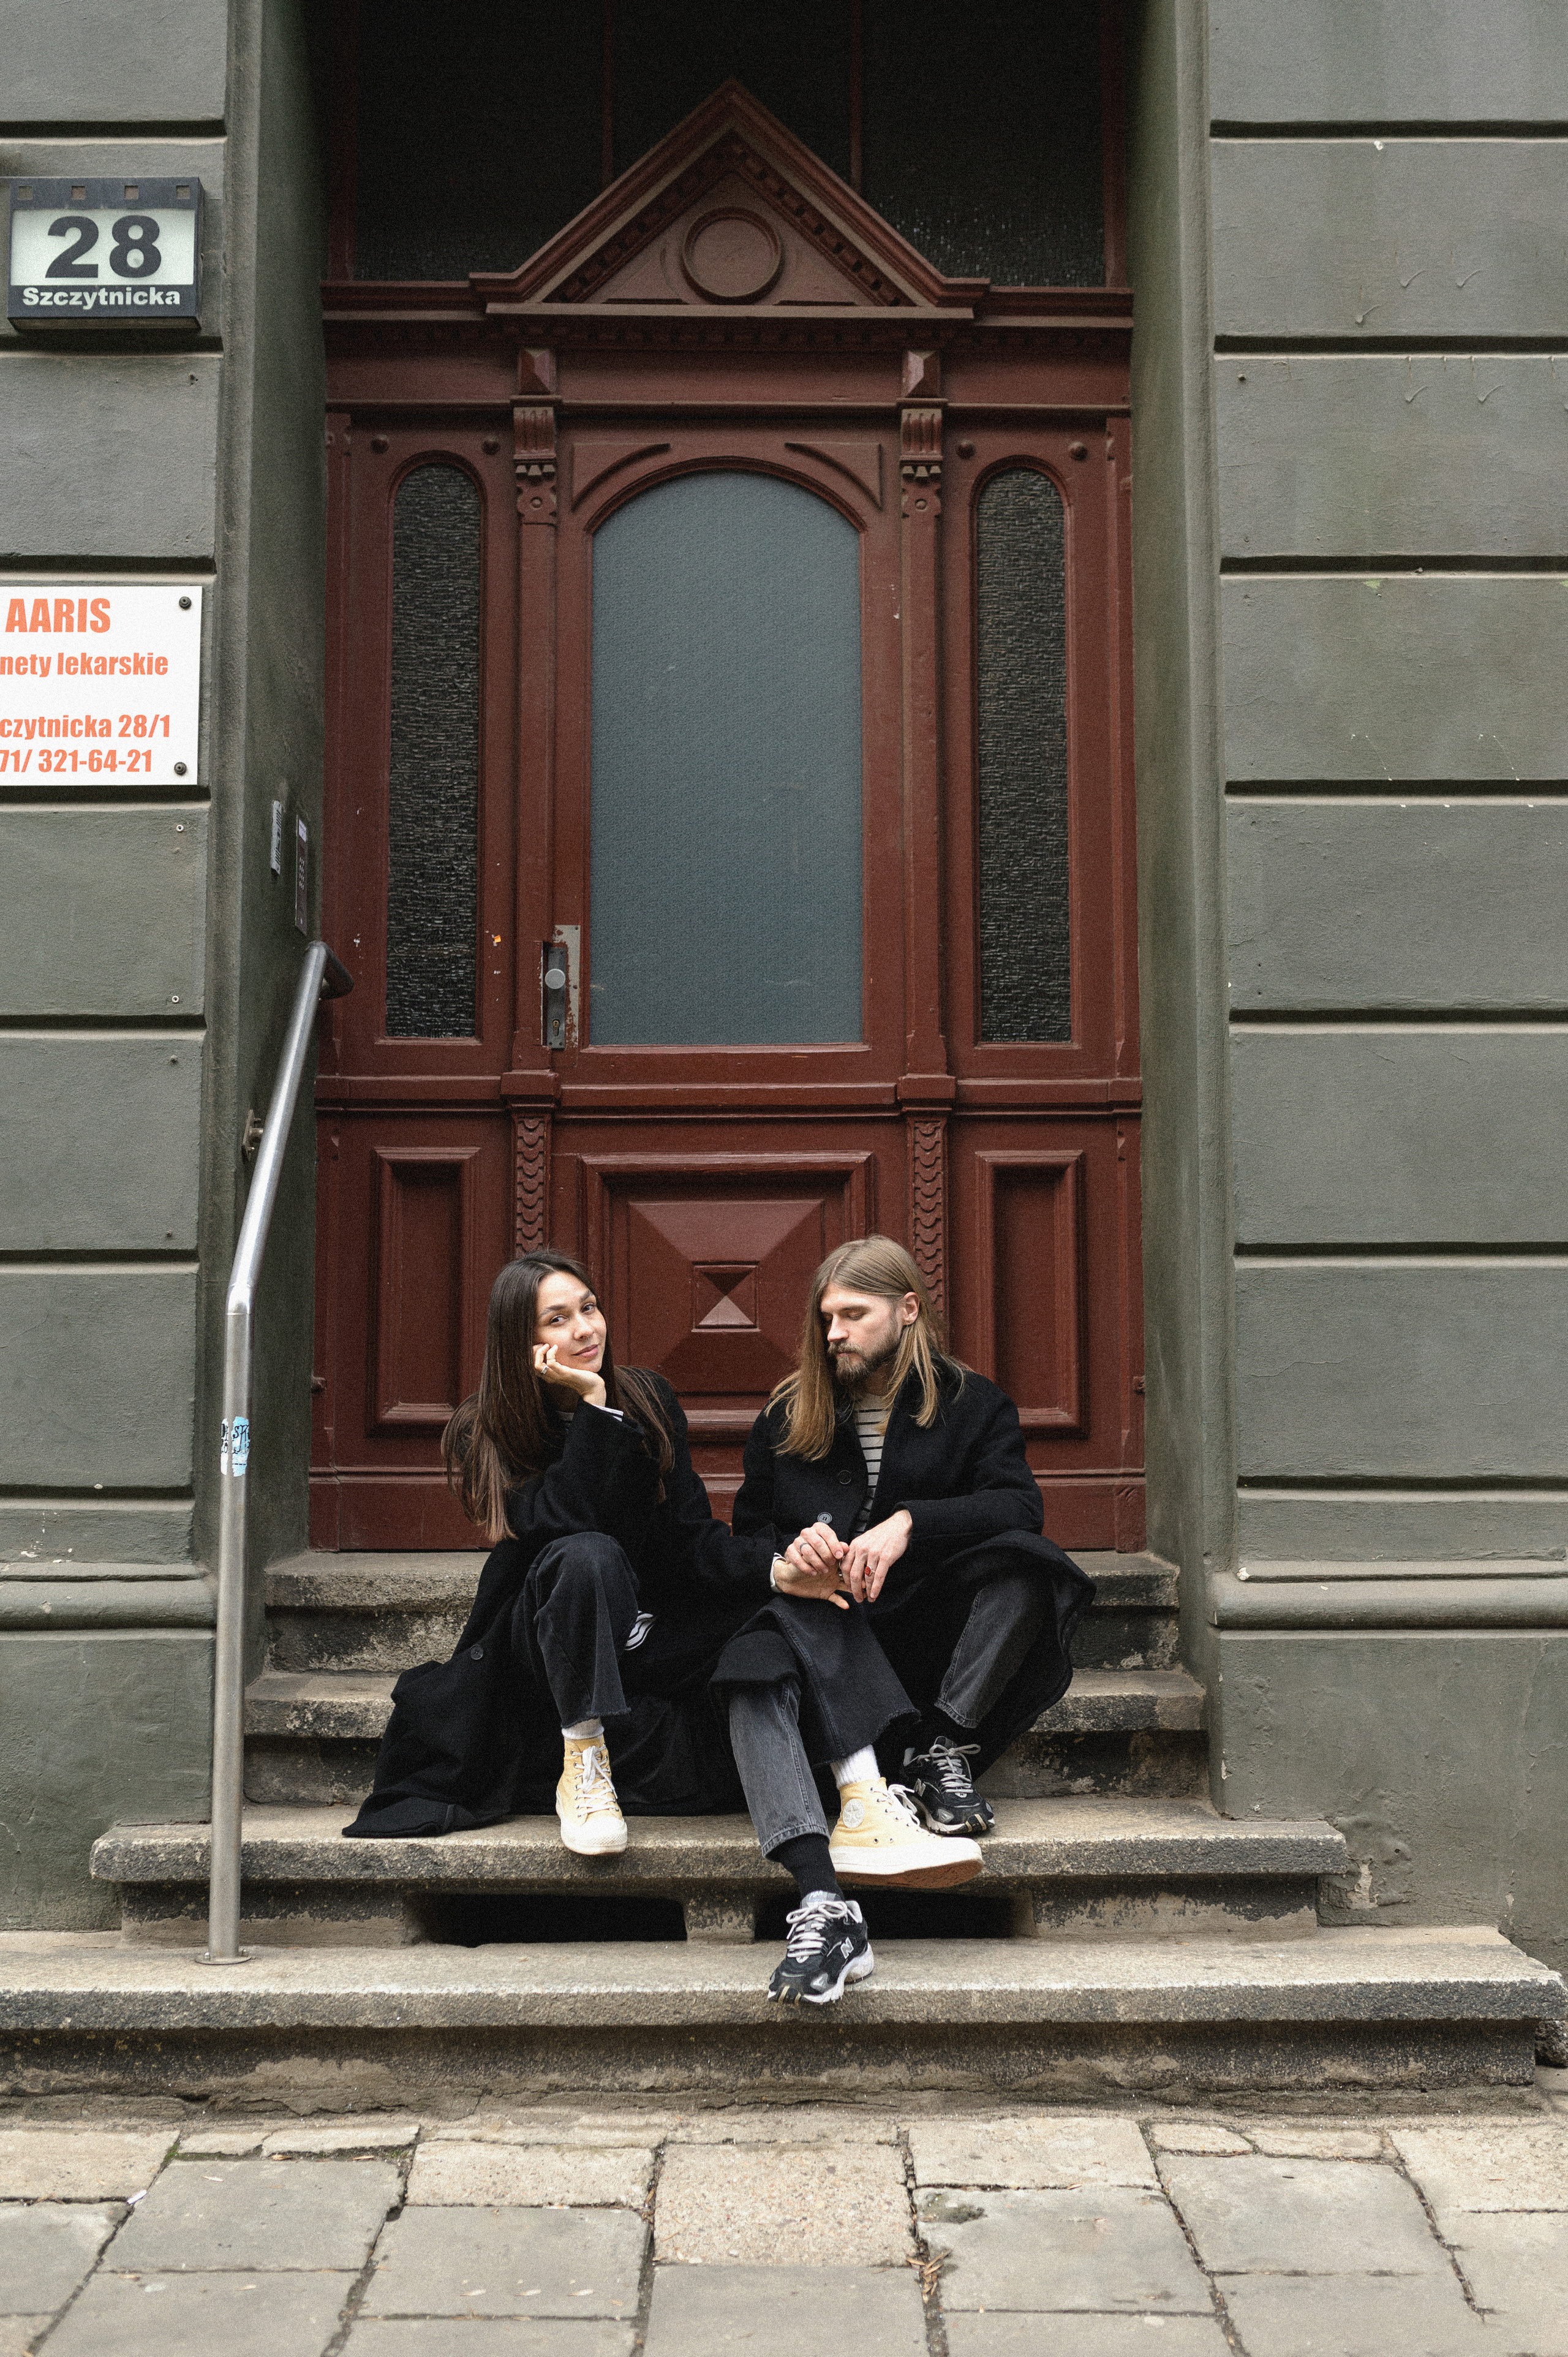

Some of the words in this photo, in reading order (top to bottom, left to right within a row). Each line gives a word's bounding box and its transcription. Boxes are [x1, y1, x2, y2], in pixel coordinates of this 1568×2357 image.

[45, 215, 161, 278] 28
[23, 287, 180, 309] Szczytnicka
[6, 598, 111, 633] AARIS
[58, 653, 168, 675] lekarskie
[118, 714, 170, 738] 28/1
[39, 749, 151, 772] 321-64-21
[840, 1937, 854, 1959] N
